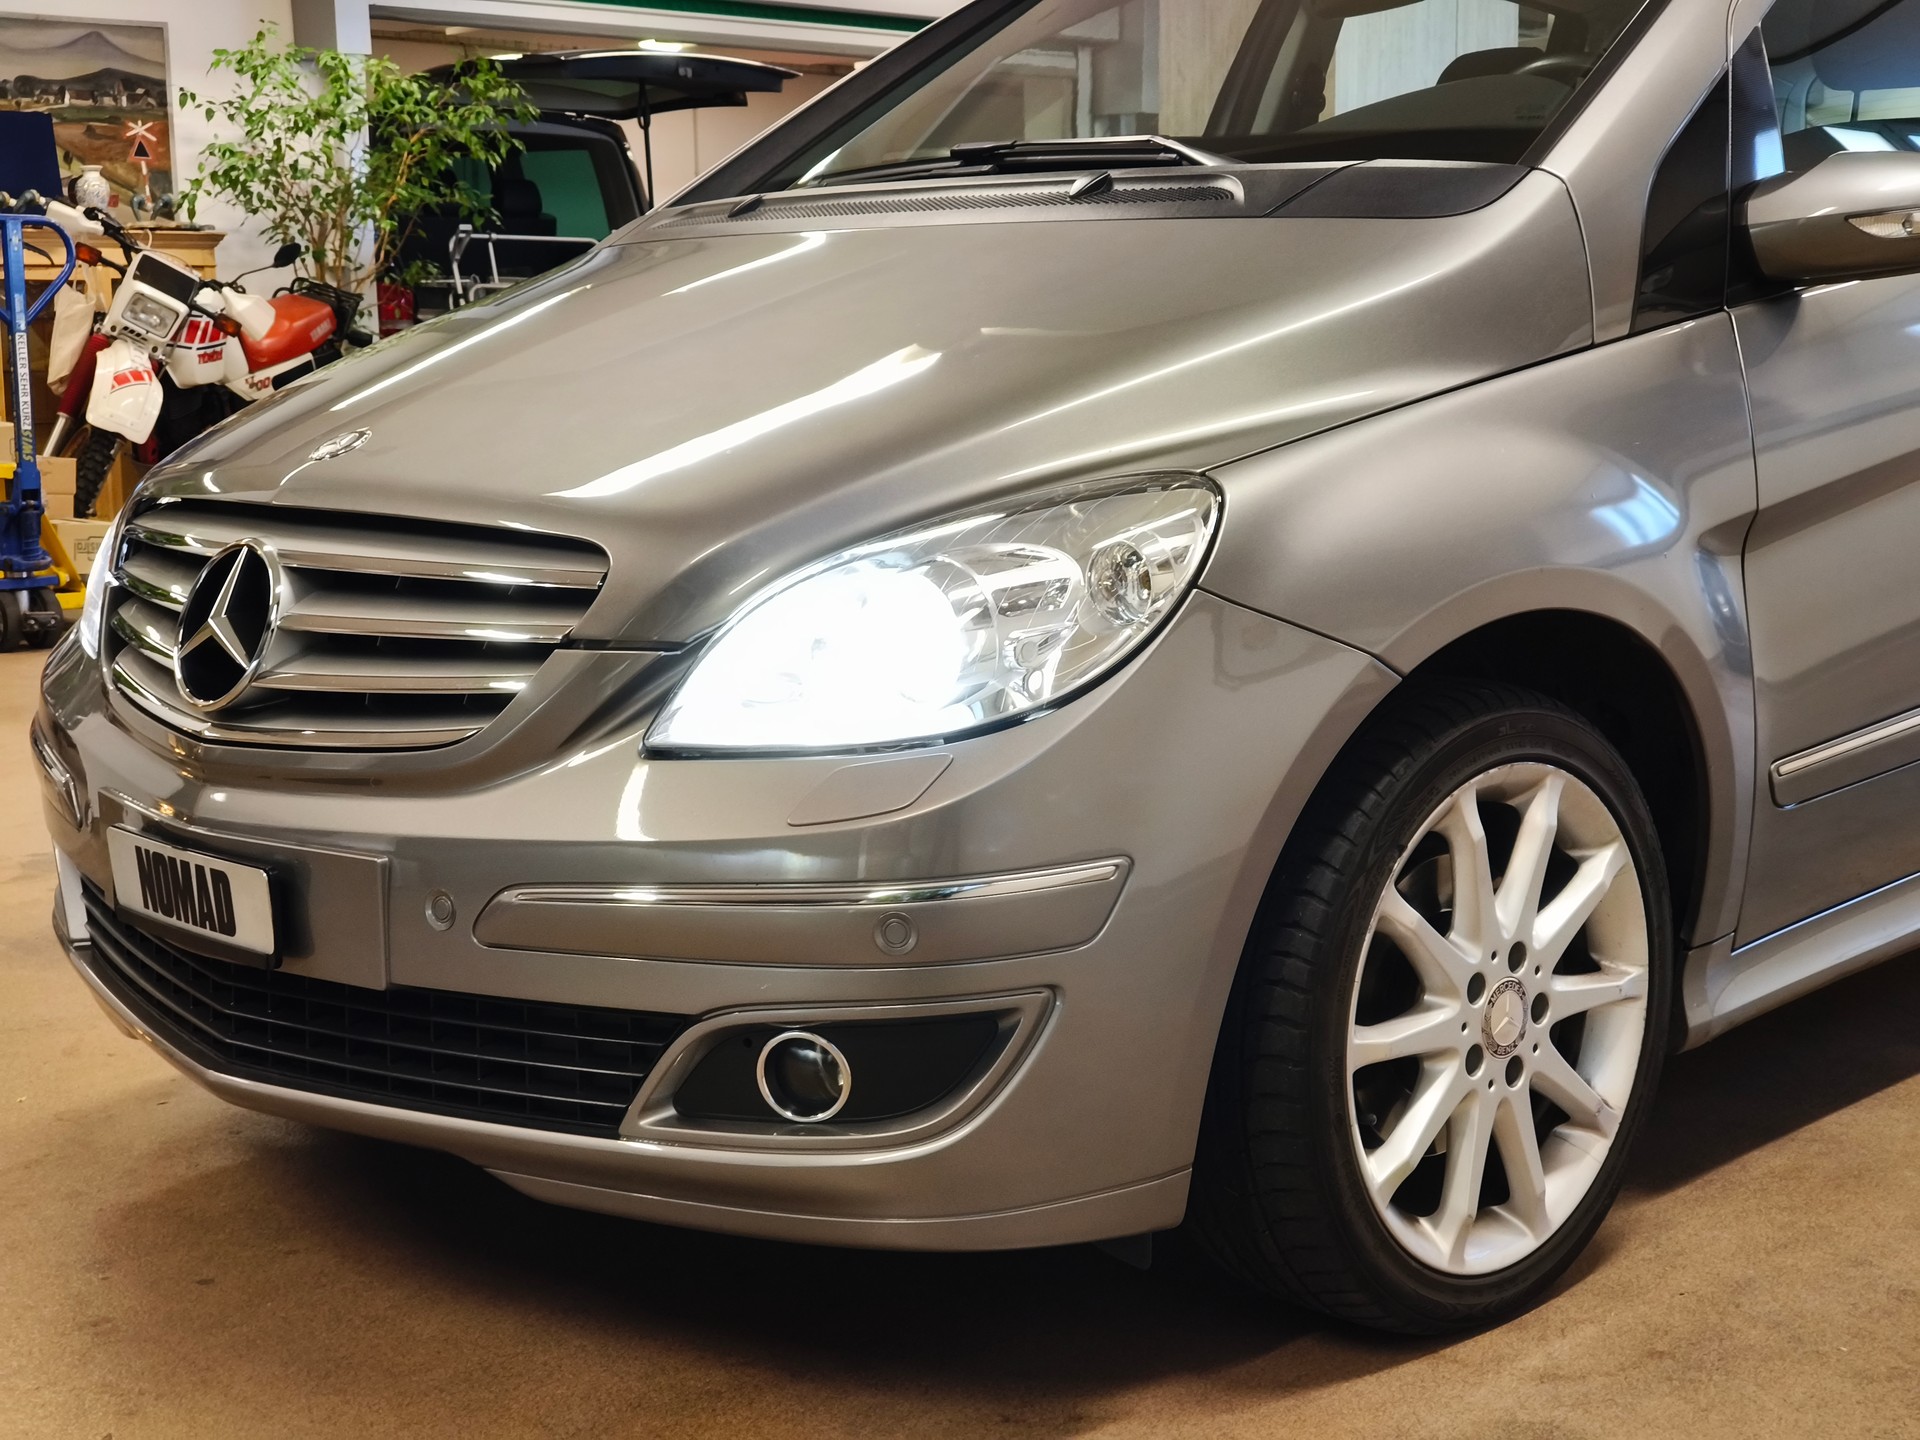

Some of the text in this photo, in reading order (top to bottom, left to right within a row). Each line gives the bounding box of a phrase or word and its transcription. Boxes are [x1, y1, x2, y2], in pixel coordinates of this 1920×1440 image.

[17, 334, 31, 427] KELLER SEHR KURZ
[134, 845, 237, 938] NOMAD
[1490, 981, 1525, 1002] MERCEDES
[1497, 1042, 1516, 1055] BENZ
